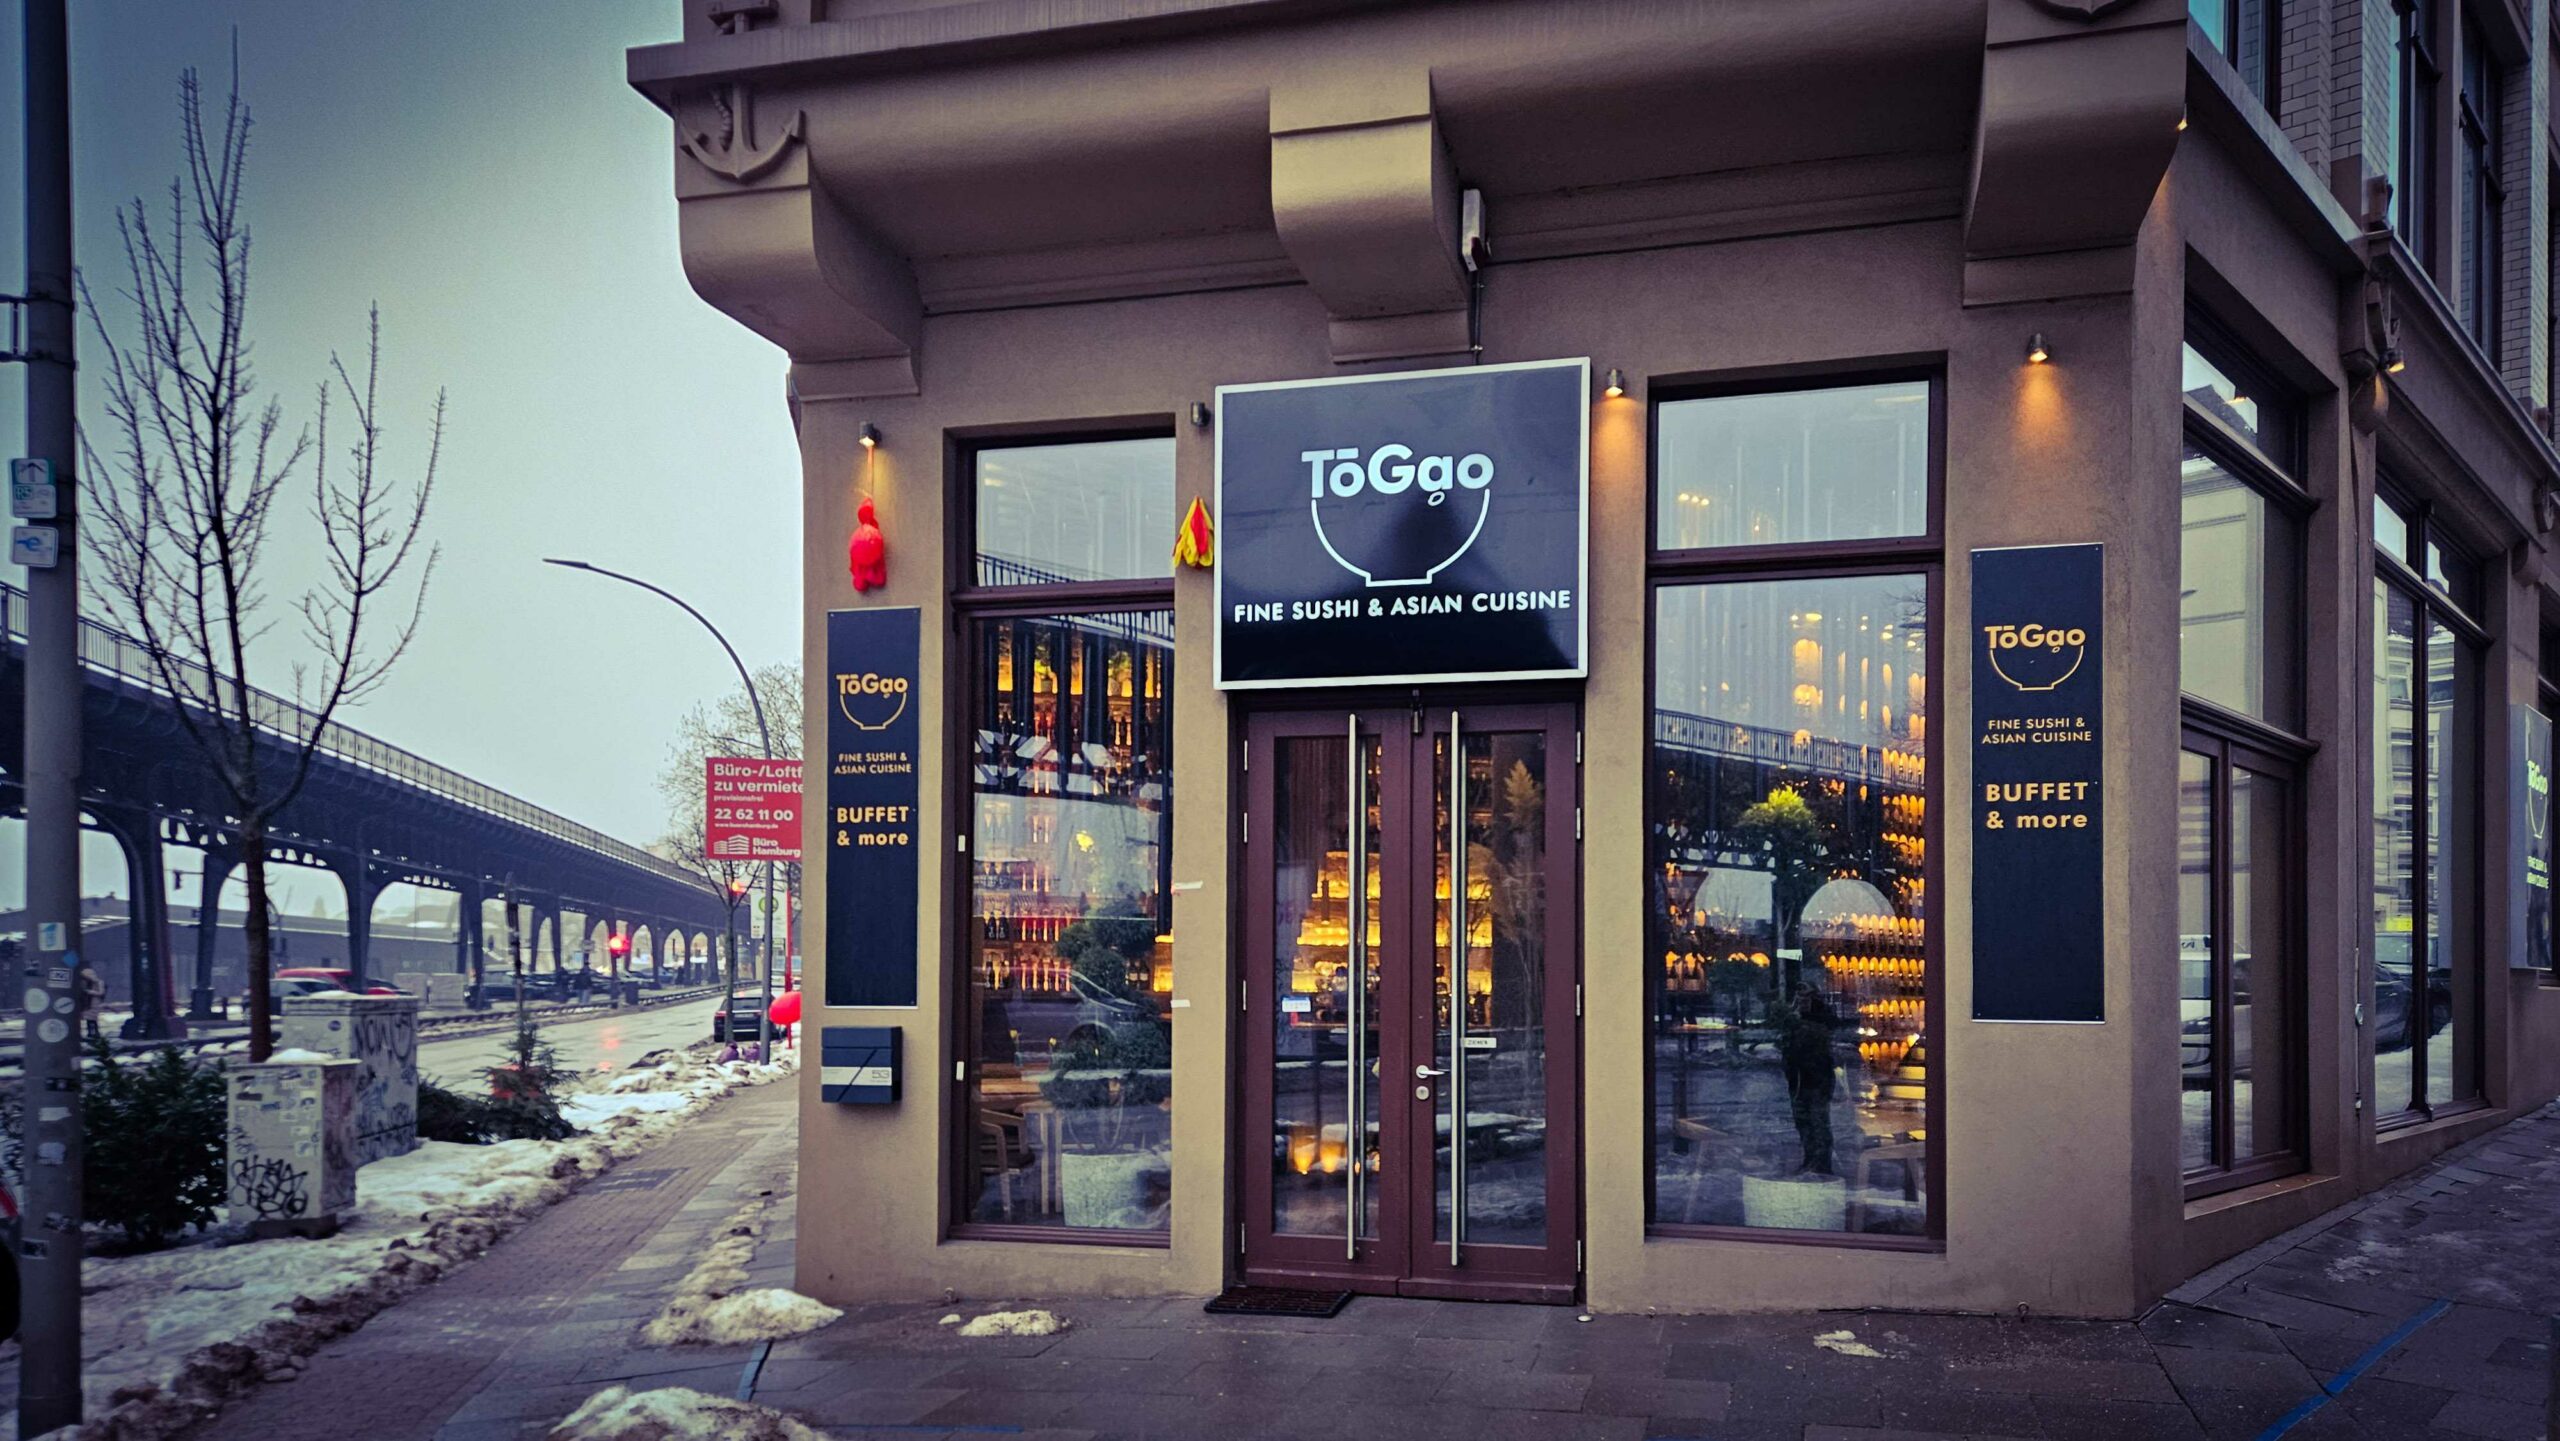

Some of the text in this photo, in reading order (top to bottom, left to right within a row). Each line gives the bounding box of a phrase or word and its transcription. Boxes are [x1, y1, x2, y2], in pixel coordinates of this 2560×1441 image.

[1234, 590, 1571, 623] FINE SUSHI & ASIAN CUISINE
[1988, 716, 2086, 730] FINE SUSHI &
[1982, 731, 2092, 744] ASIAN CUISINE
[838, 752, 907, 762] FINE SUSHI &
[834, 763, 912, 774] ASIAN CUISINE
[714, 781, 733, 791] zu
[1986, 782, 2089, 803] BUFFET
[714, 808, 794, 821] 22 62 11 00
[837, 806, 909, 823] BUFFET
[1986, 810, 2088, 829] & more
[752, 837, 778, 846] Büro
[837, 830, 909, 846] & more
[752, 846, 801, 858] Hamburg
